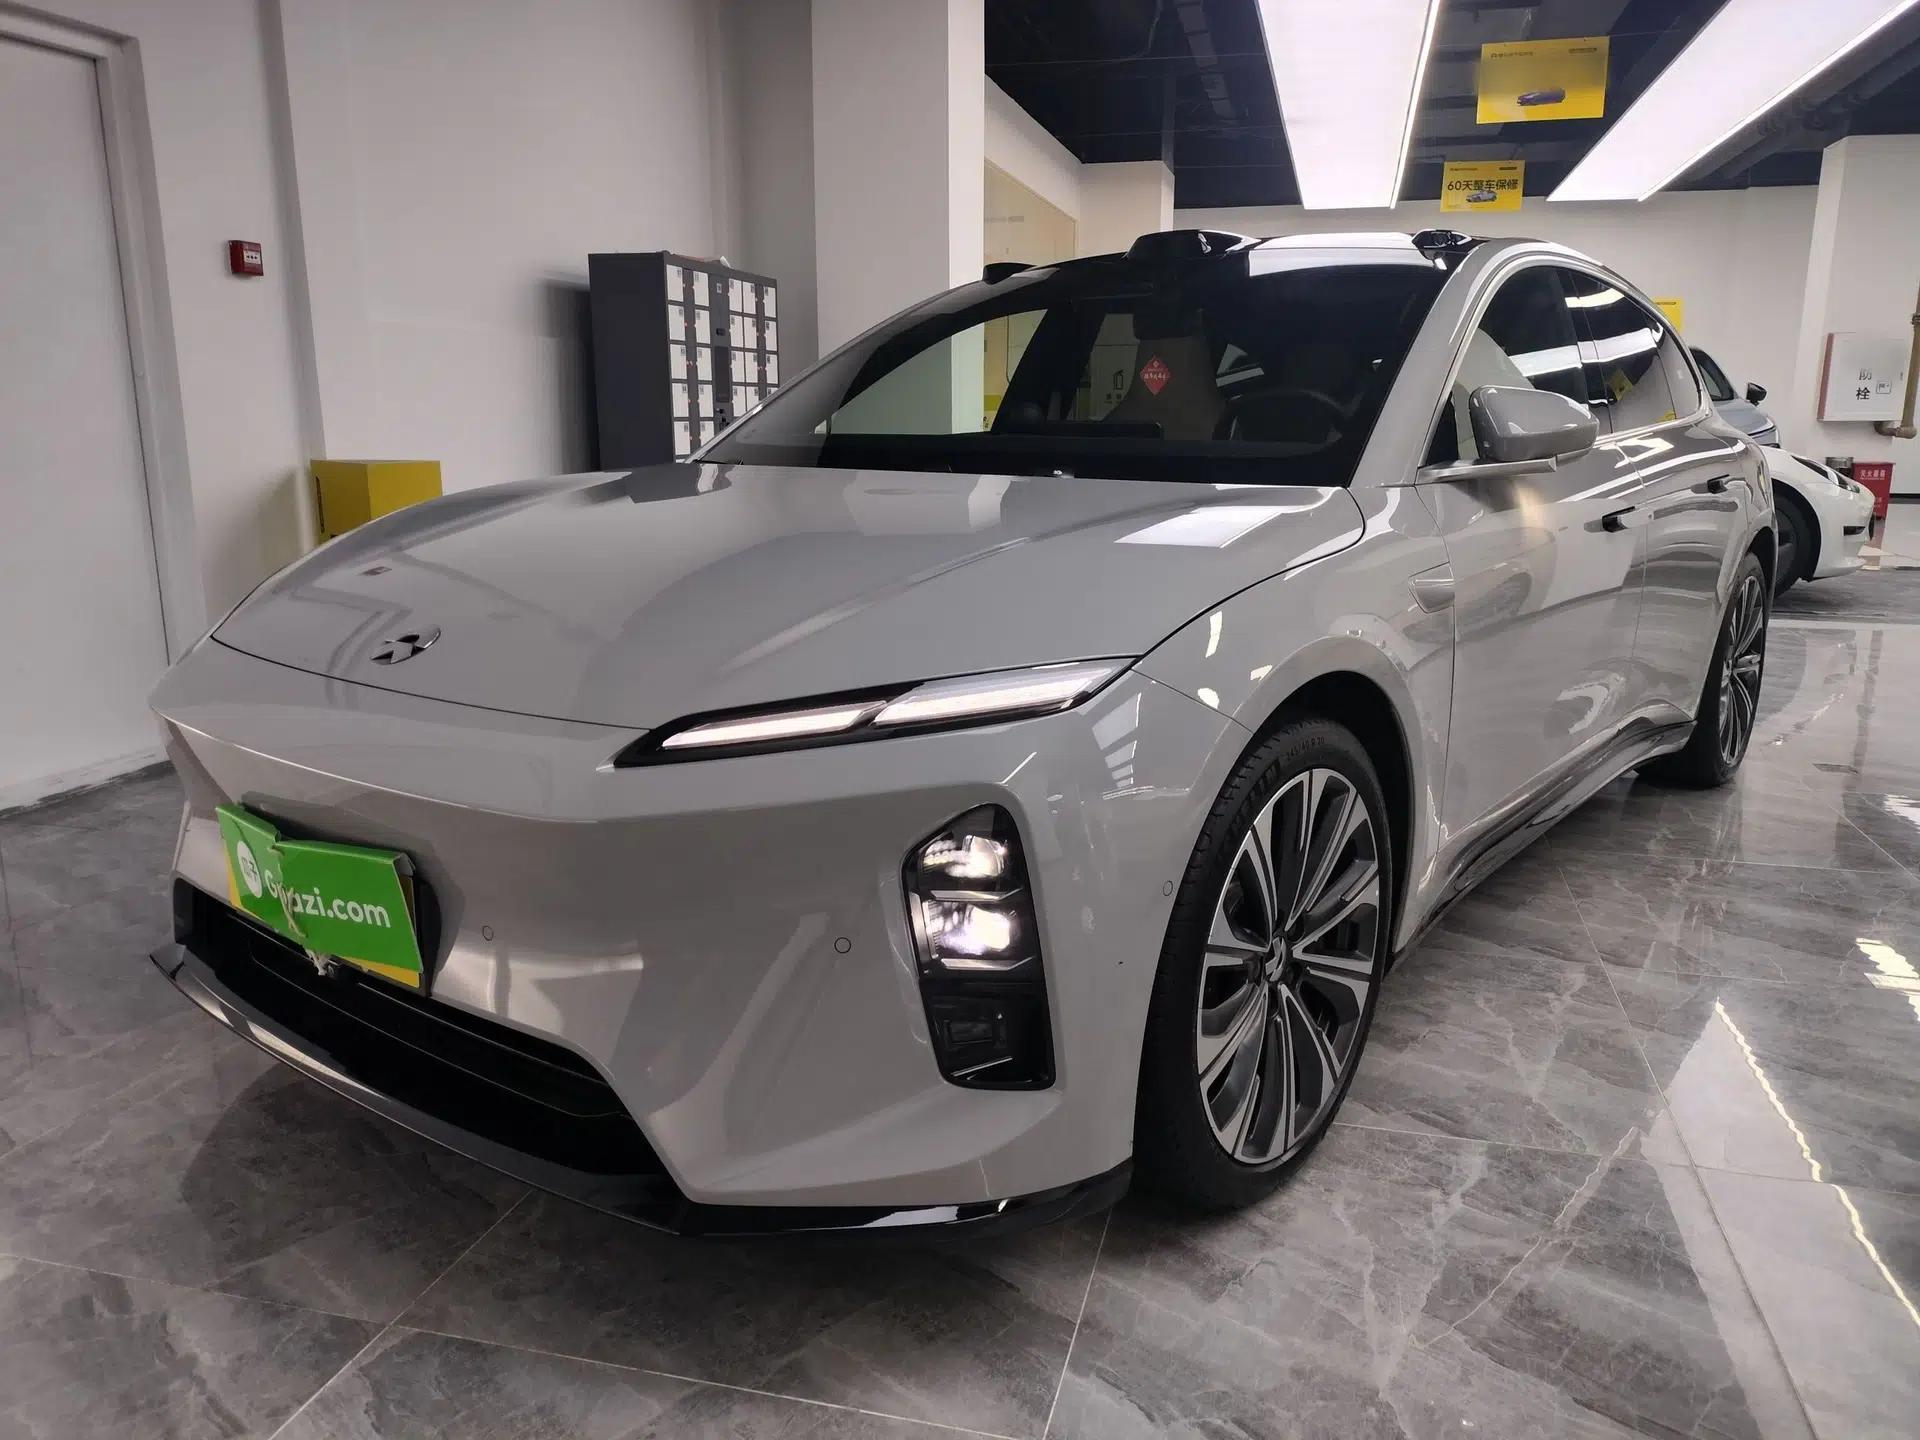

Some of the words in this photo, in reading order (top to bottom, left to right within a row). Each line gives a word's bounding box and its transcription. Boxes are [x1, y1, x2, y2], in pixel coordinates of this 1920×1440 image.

[1447, 179, 1519, 191] 60天整车保修
[264, 869, 391, 929] Gazi.com
